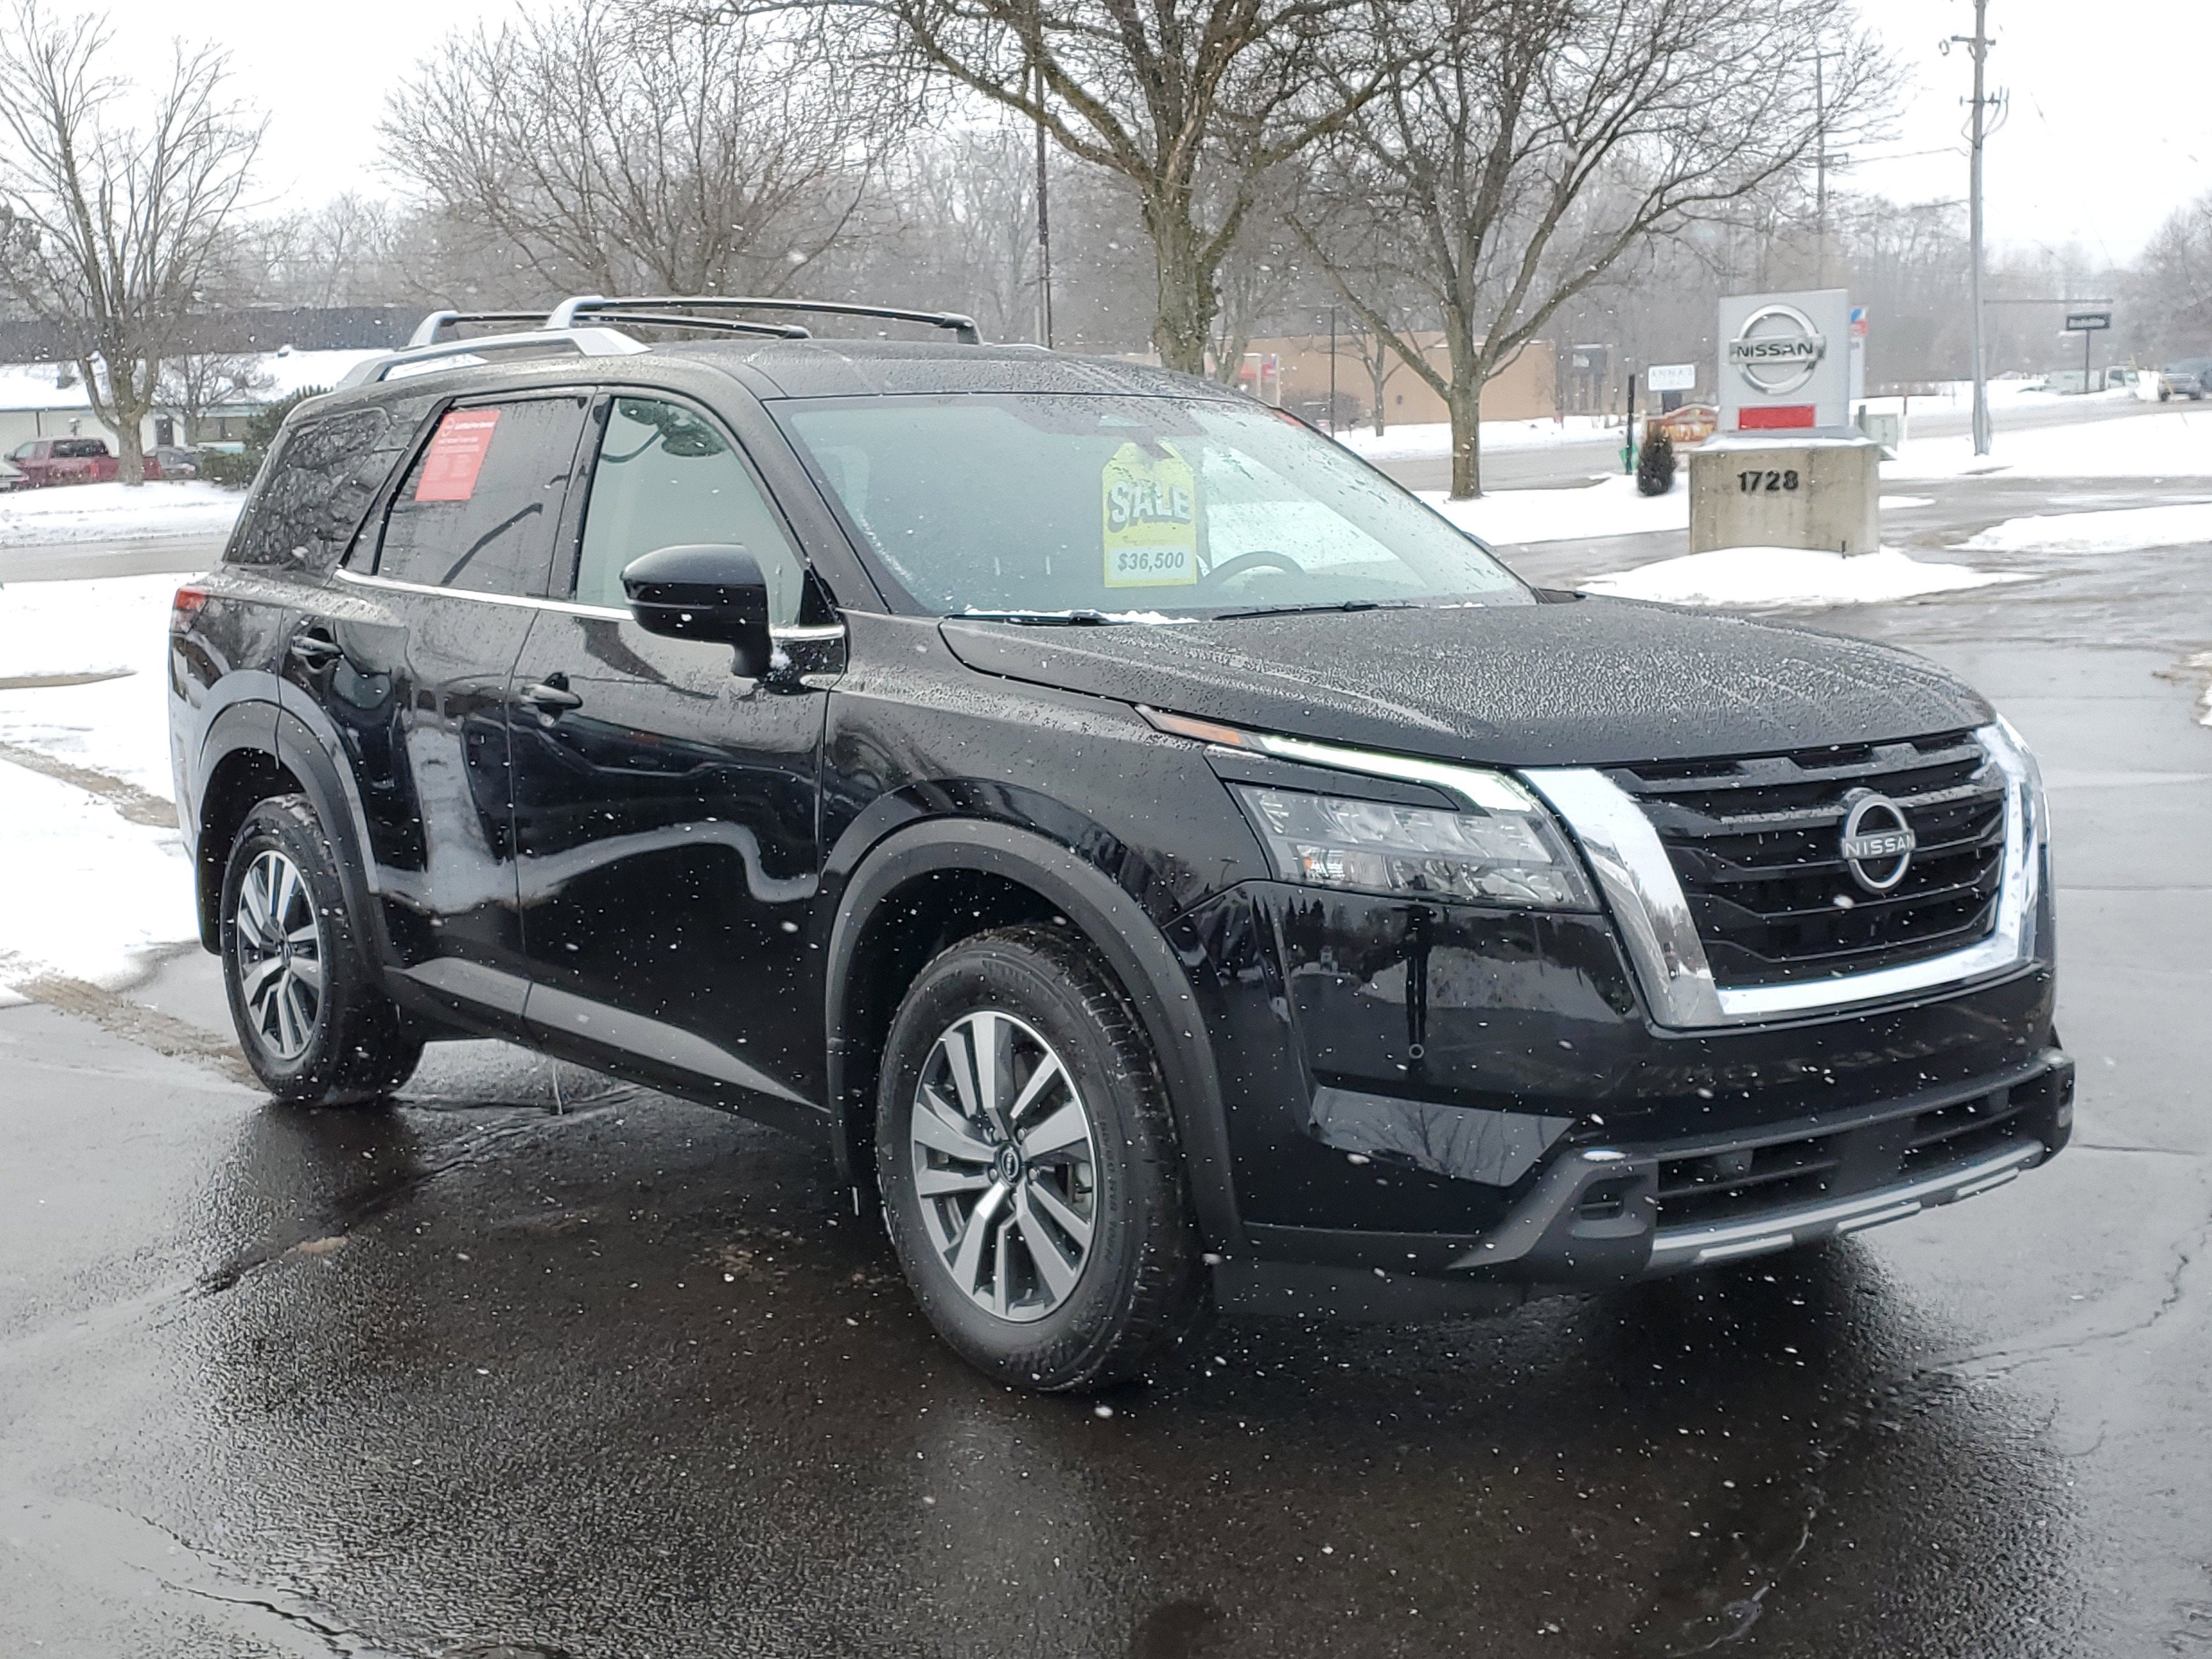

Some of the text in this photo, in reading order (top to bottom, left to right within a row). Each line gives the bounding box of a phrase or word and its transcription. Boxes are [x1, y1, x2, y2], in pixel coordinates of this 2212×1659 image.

[1736, 343, 1813, 358] NISSAN
[1737, 470, 1799, 492] 1728
[1108, 479, 1192, 530] SALE
[1118, 552, 1184, 572] $36,500
[1846, 834, 1914, 857] NISSAN
